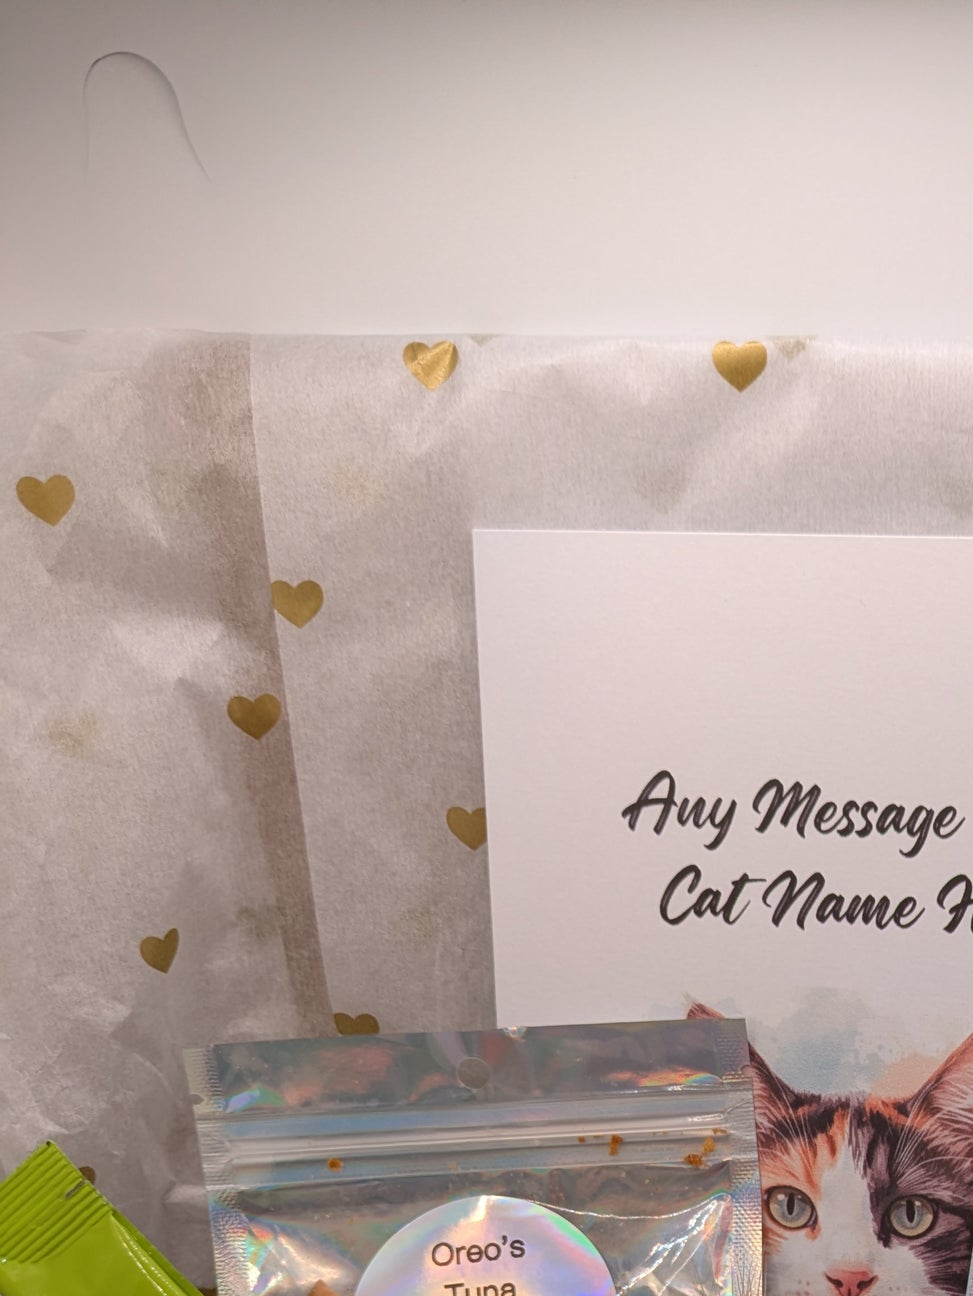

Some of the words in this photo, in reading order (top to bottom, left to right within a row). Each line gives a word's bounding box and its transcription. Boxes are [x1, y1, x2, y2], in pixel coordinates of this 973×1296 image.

[622, 770, 737, 850] Any
[752, 779, 965, 858] Message
[659, 864, 767, 926] Cat
[762, 870, 924, 931] Name
[431, 1235, 526, 1267] Oreo's
